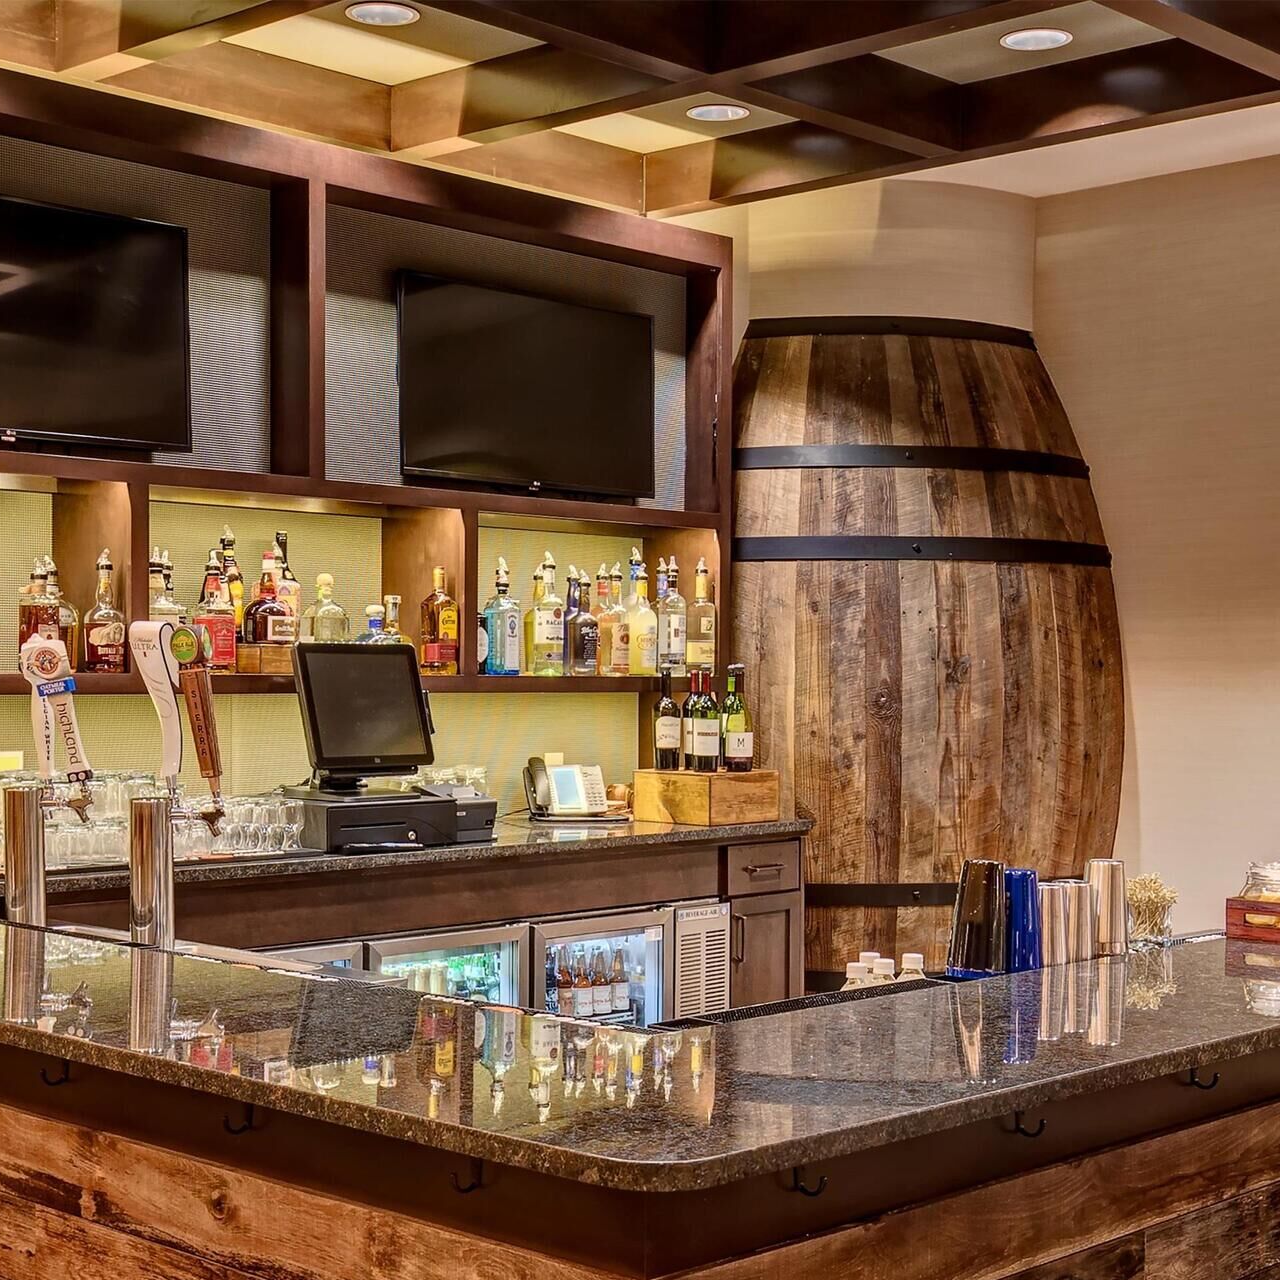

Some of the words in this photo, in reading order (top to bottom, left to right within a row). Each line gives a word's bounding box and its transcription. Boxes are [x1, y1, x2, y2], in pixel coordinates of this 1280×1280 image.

[131, 641, 159, 650] ULTRA
[42, 697, 51, 731] ELGIAN
[190, 689, 208, 757] SIERRA
